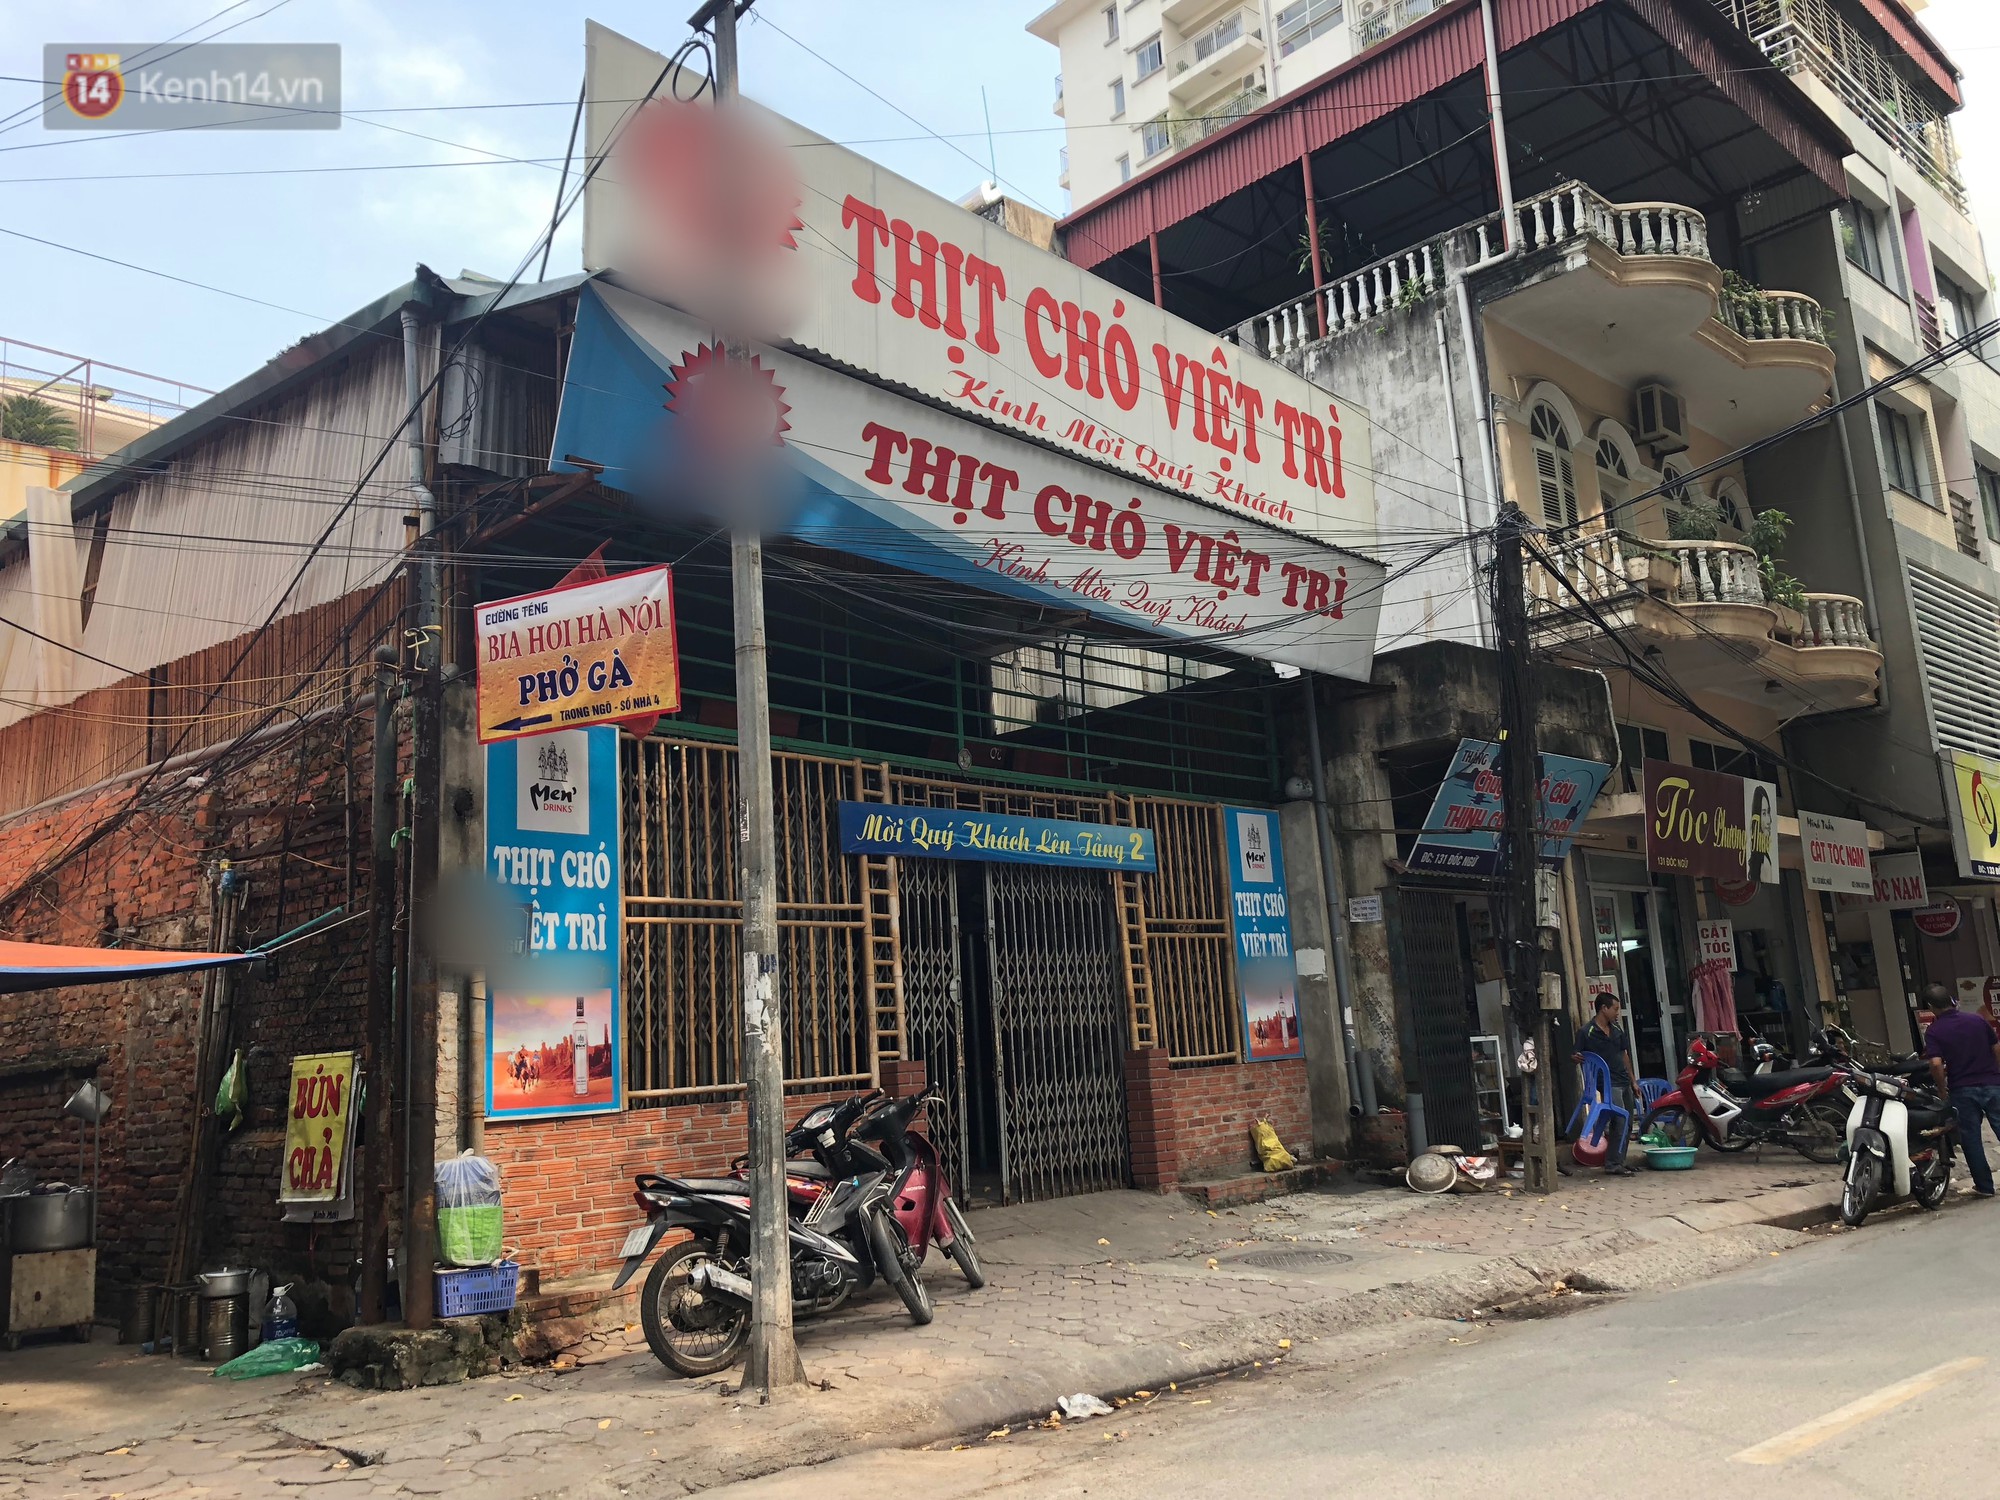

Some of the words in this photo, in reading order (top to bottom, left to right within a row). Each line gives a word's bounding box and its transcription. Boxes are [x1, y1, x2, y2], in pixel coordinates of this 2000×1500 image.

[841, 194, 1006, 363] THỊT
[1024, 287, 1140, 411] CHÓ
[1152, 343, 1263, 472] VIỆT
[1274, 399, 1346, 499] TRÌ
[943, 369, 1050, 432] Kính
[1057, 418, 1127, 461] Mời
[1135, 445, 1195, 491] Quý
[1203, 470, 1296, 524] Khách
[862, 421, 1019, 525] THỊT
[1033, 485, 1147, 559] CHÓ
[1163, 524, 1271, 600] VIỆT
[1281, 562, 1350, 619] TRÌ
[972, 537, 1050, 584] Kính
[1053, 565, 1112, 602] Mời
[1120, 580, 1172, 628] Quý
[1177, 595, 1247, 637] Khách
[485, 608, 519, 626] CƯỜNG
[487, 630, 522, 663] BIA
[528, 618, 572, 655] HƠI
[576, 606, 613, 644] HÀ
[617, 596, 664, 636] NỘI
[518, 655, 580, 706] PHỞ
[587, 648, 633, 691] GÀ
[560, 706, 590, 721] TRONG
[592, 701, 612, 716] NGÕ
[620, 694, 631, 711] SỐ
[633, 694, 652, 708] NHÀ
[654, 694, 660, 705] 4
[530, 782, 577, 812] Men'
[543, 803, 574, 814] DRINKS
[1655, 777, 1710, 844] Tóc
[856, 813, 904, 843] Mời
[910, 816, 954, 851] Quý
[960, 821, 1031, 852] Khách
[1035, 828, 1072, 855] Lên
[1076, 829, 1126, 865] Tầng
[1129, 833, 1145, 861] 2
[1846, 848, 1866, 868] NAM
[493, 845, 555, 895] THỊT
[560, 841, 611, 889] CHÓ
[1891, 876, 1922, 901] NAM
[564, 903, 607, 951] TRÌ
[1235, 892, 1261, 923] THỊT
[1263, 887, 1285, 917] CHÓ
[1241, 926, 1267, 963] VIỆT
[1269, 926, 1288, 957] TRÌ
[1704, 939, 1731, 954] TÓC
[294, 1063, 344, 1119] BÚN
[289, 1127, 333, 1190] CHẢ
